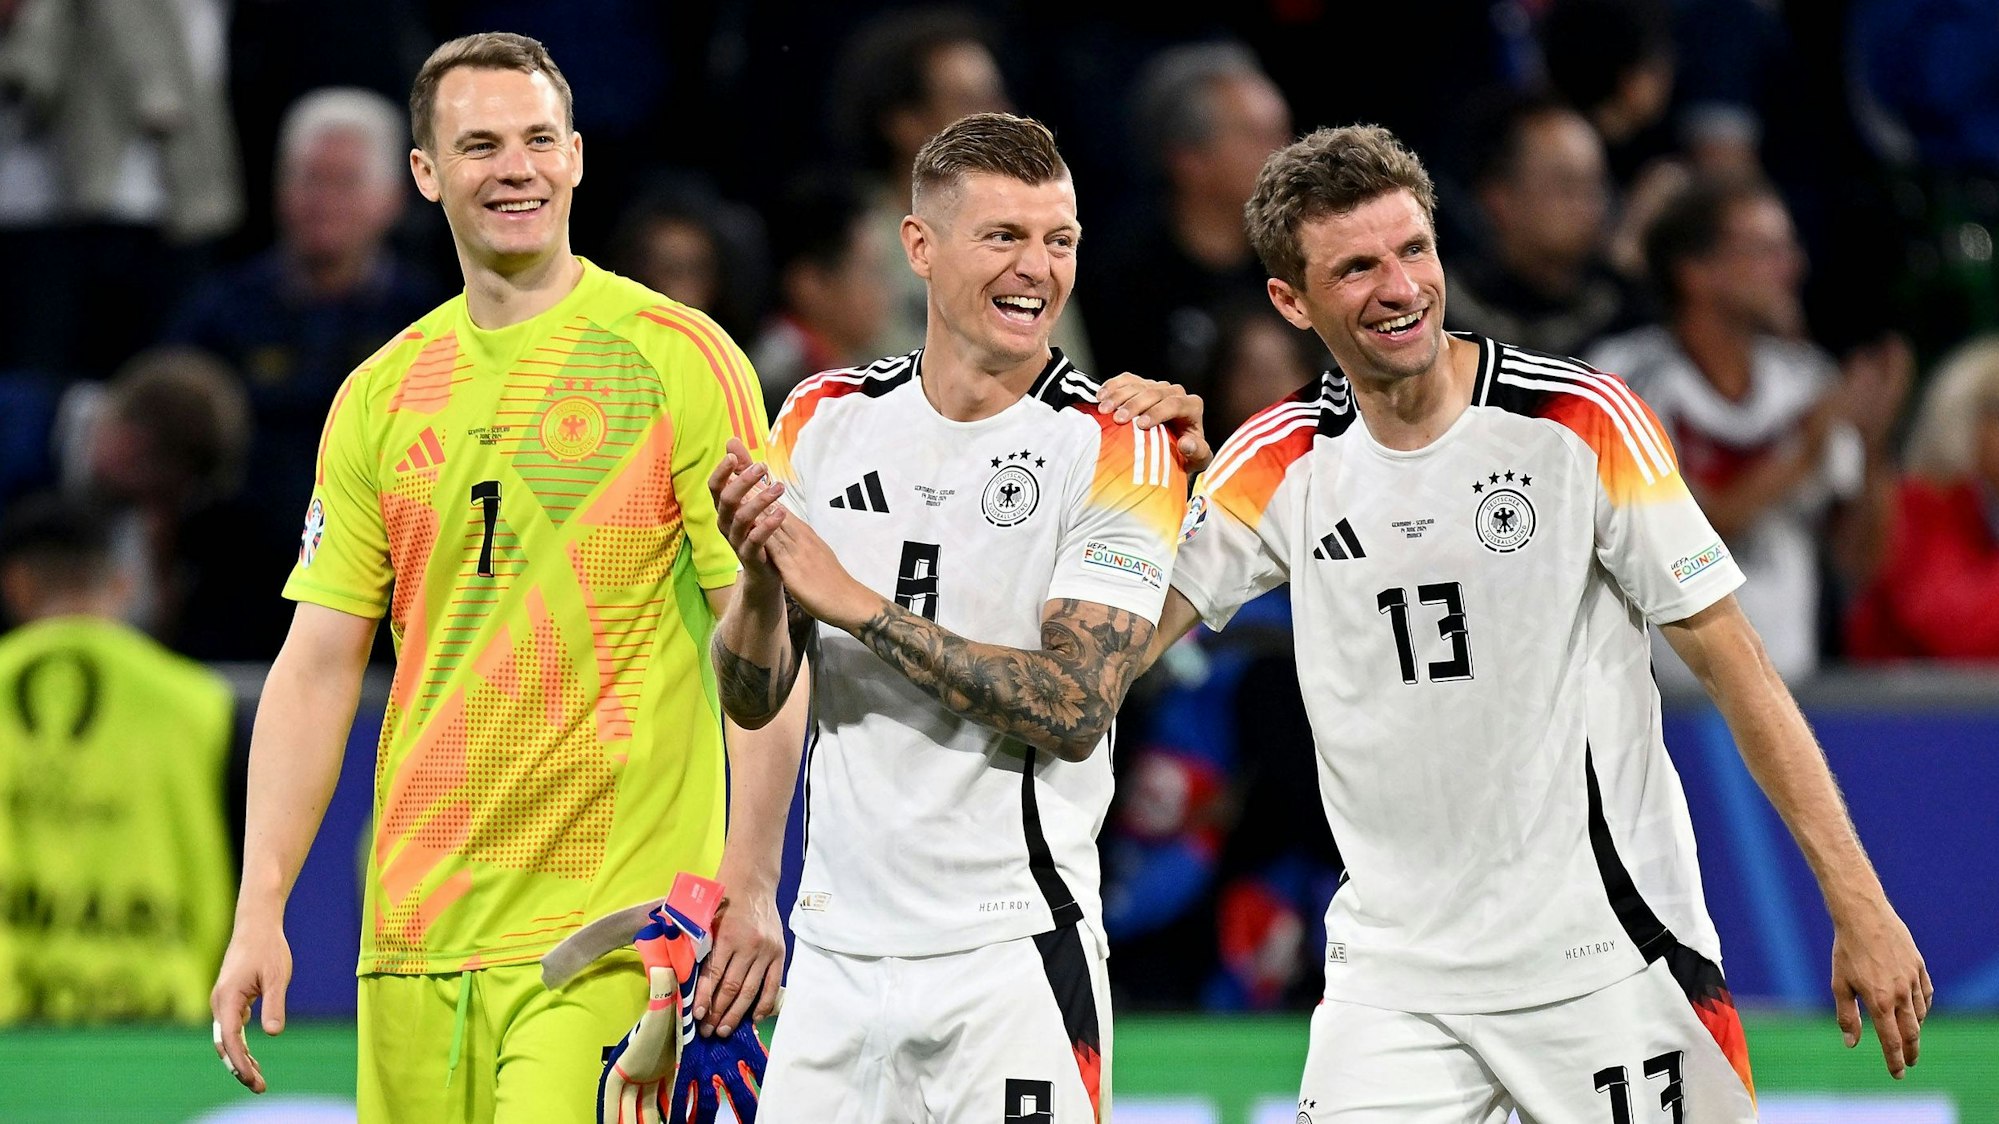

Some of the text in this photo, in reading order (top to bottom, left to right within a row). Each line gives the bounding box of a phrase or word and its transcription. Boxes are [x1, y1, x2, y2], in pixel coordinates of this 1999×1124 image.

[471, 481, 502, 577] 1
[1086, 541, 1107, 551] UEFA
[1671, 556, 1690, 571] UEFA
[1674, 545, 1724, 581] FOUNDA
[1377, 582, 1474, 685] 13
[1593, 1050, 1685, 1124] 13
